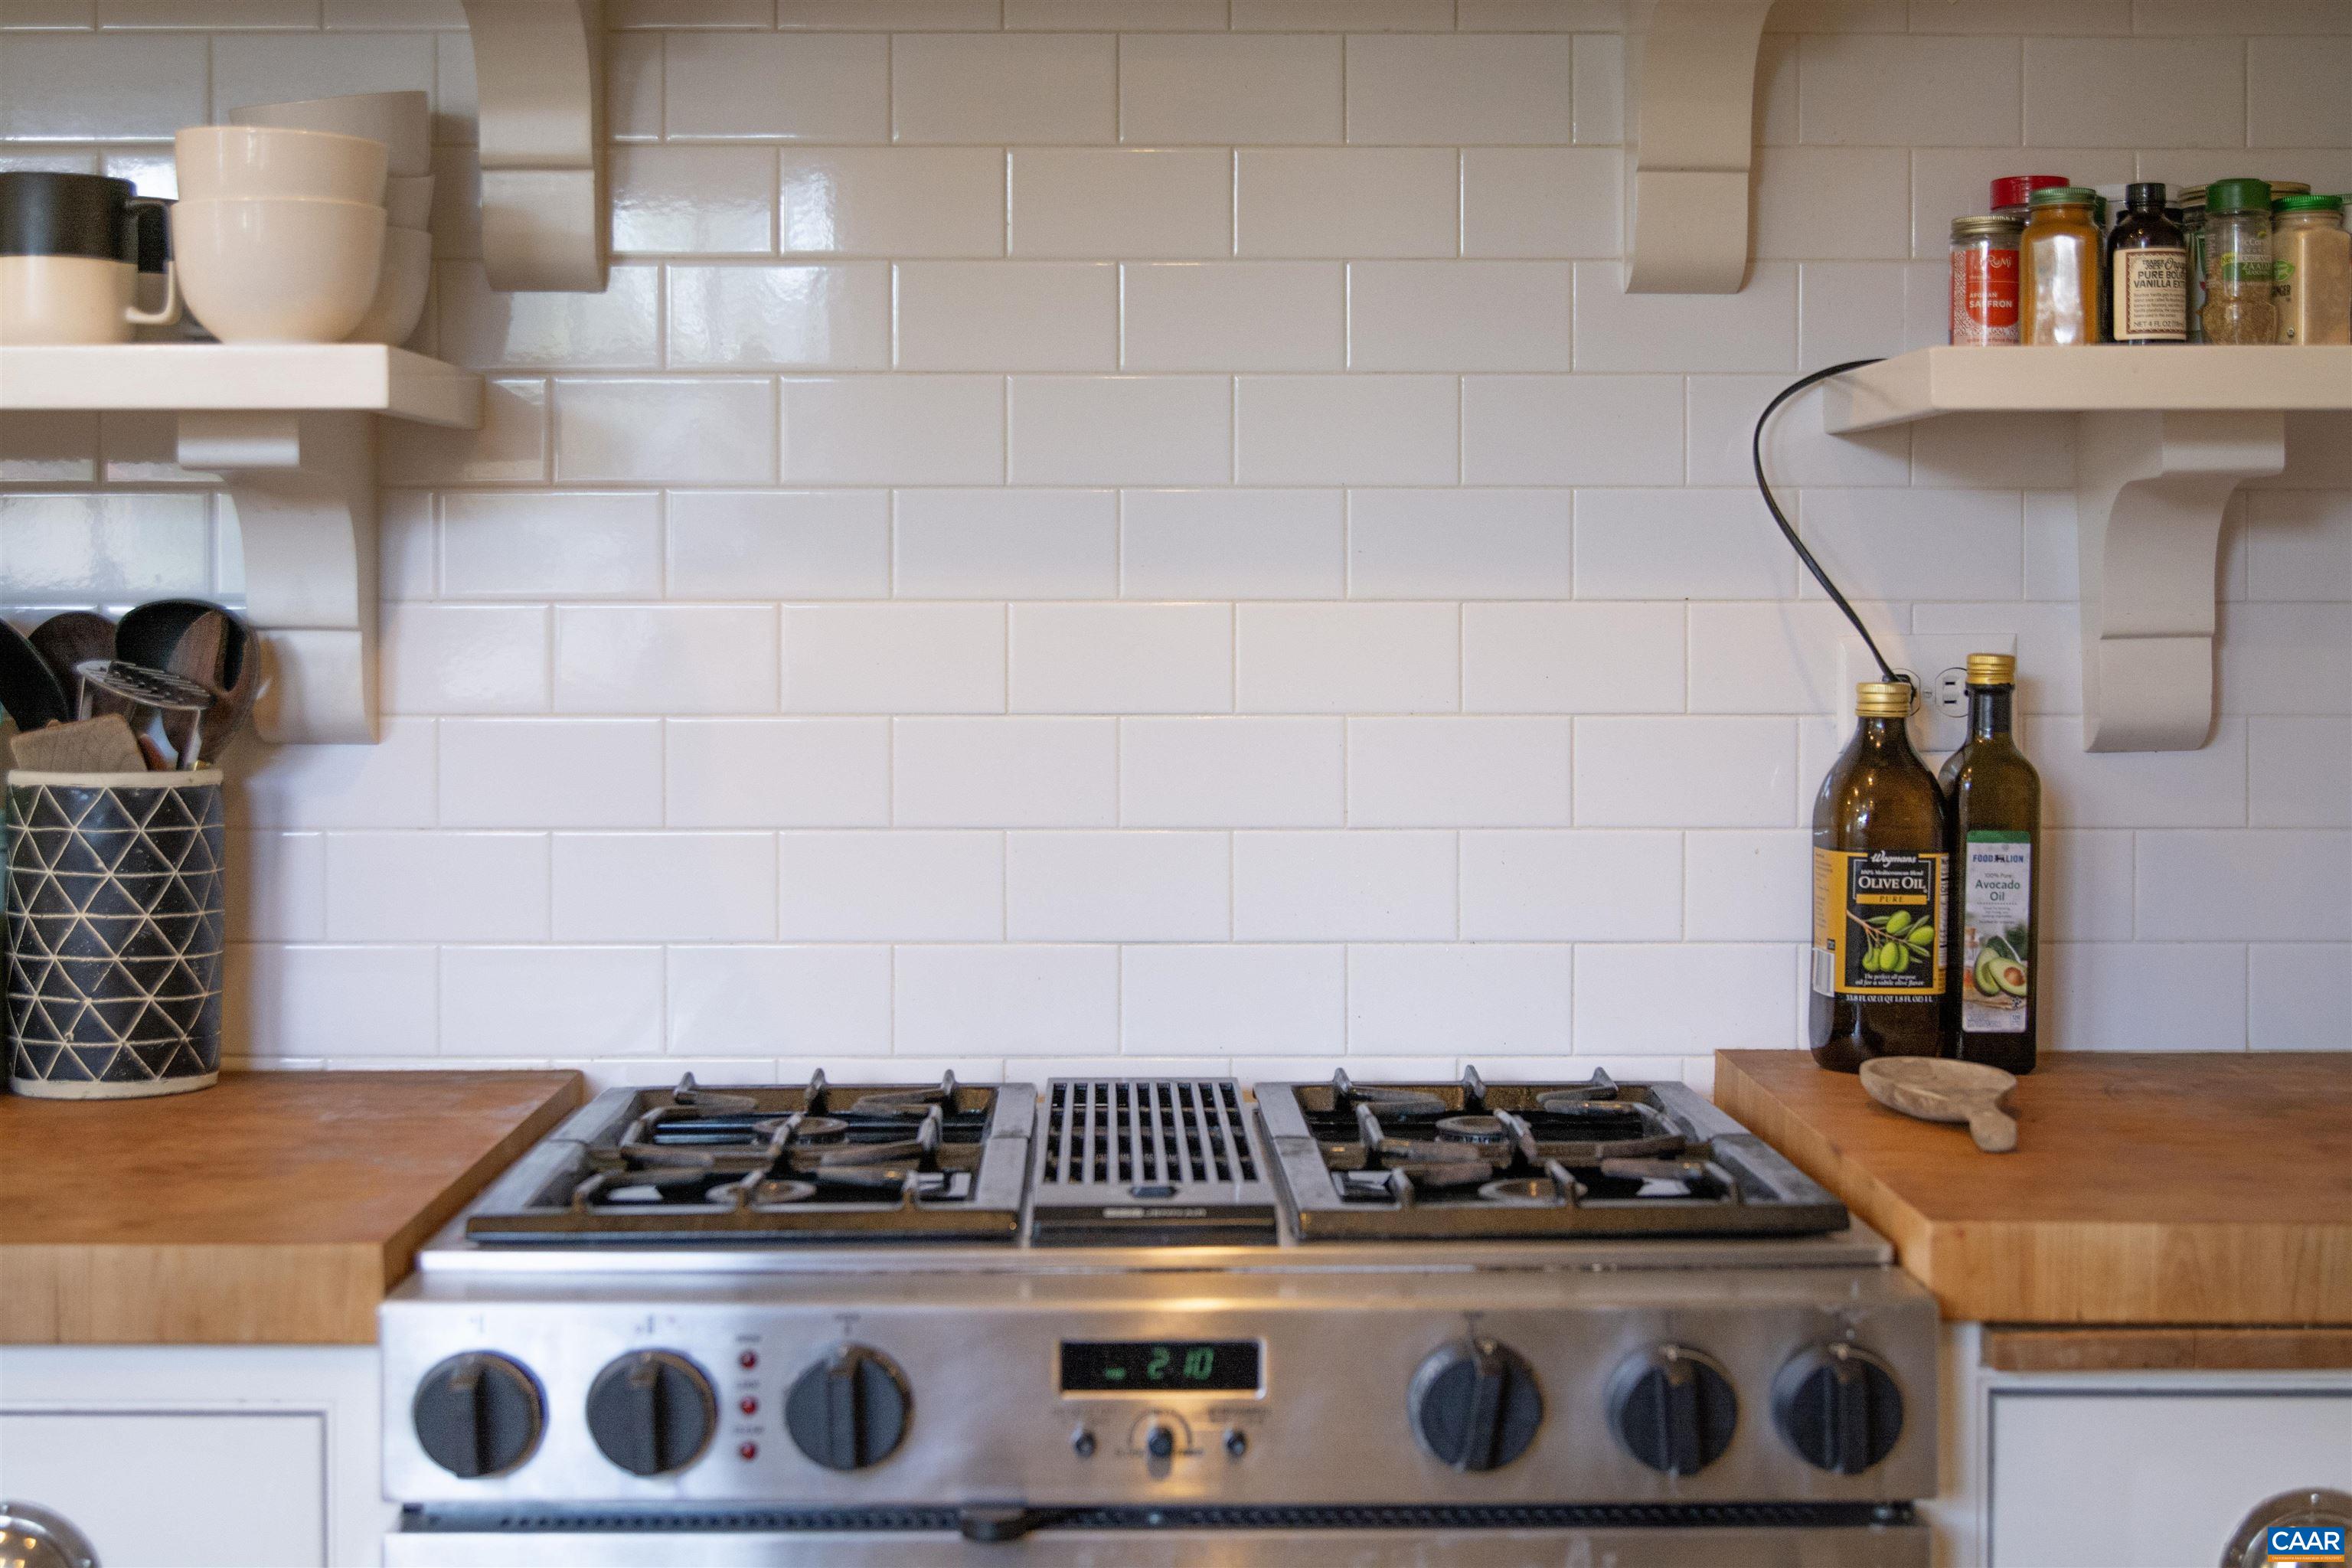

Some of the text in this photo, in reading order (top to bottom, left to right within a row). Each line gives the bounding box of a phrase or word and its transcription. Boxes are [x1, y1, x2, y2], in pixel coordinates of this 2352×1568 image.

[1870, 850, 1917, 868] Wegmans
[2006, 854, 2024, 863] LION
[1858, 876, 1926, 889] OLIVE OIL
[1975, 879, 2020, 889] Avocado
[1990, 891, 2004, 901] Oil
